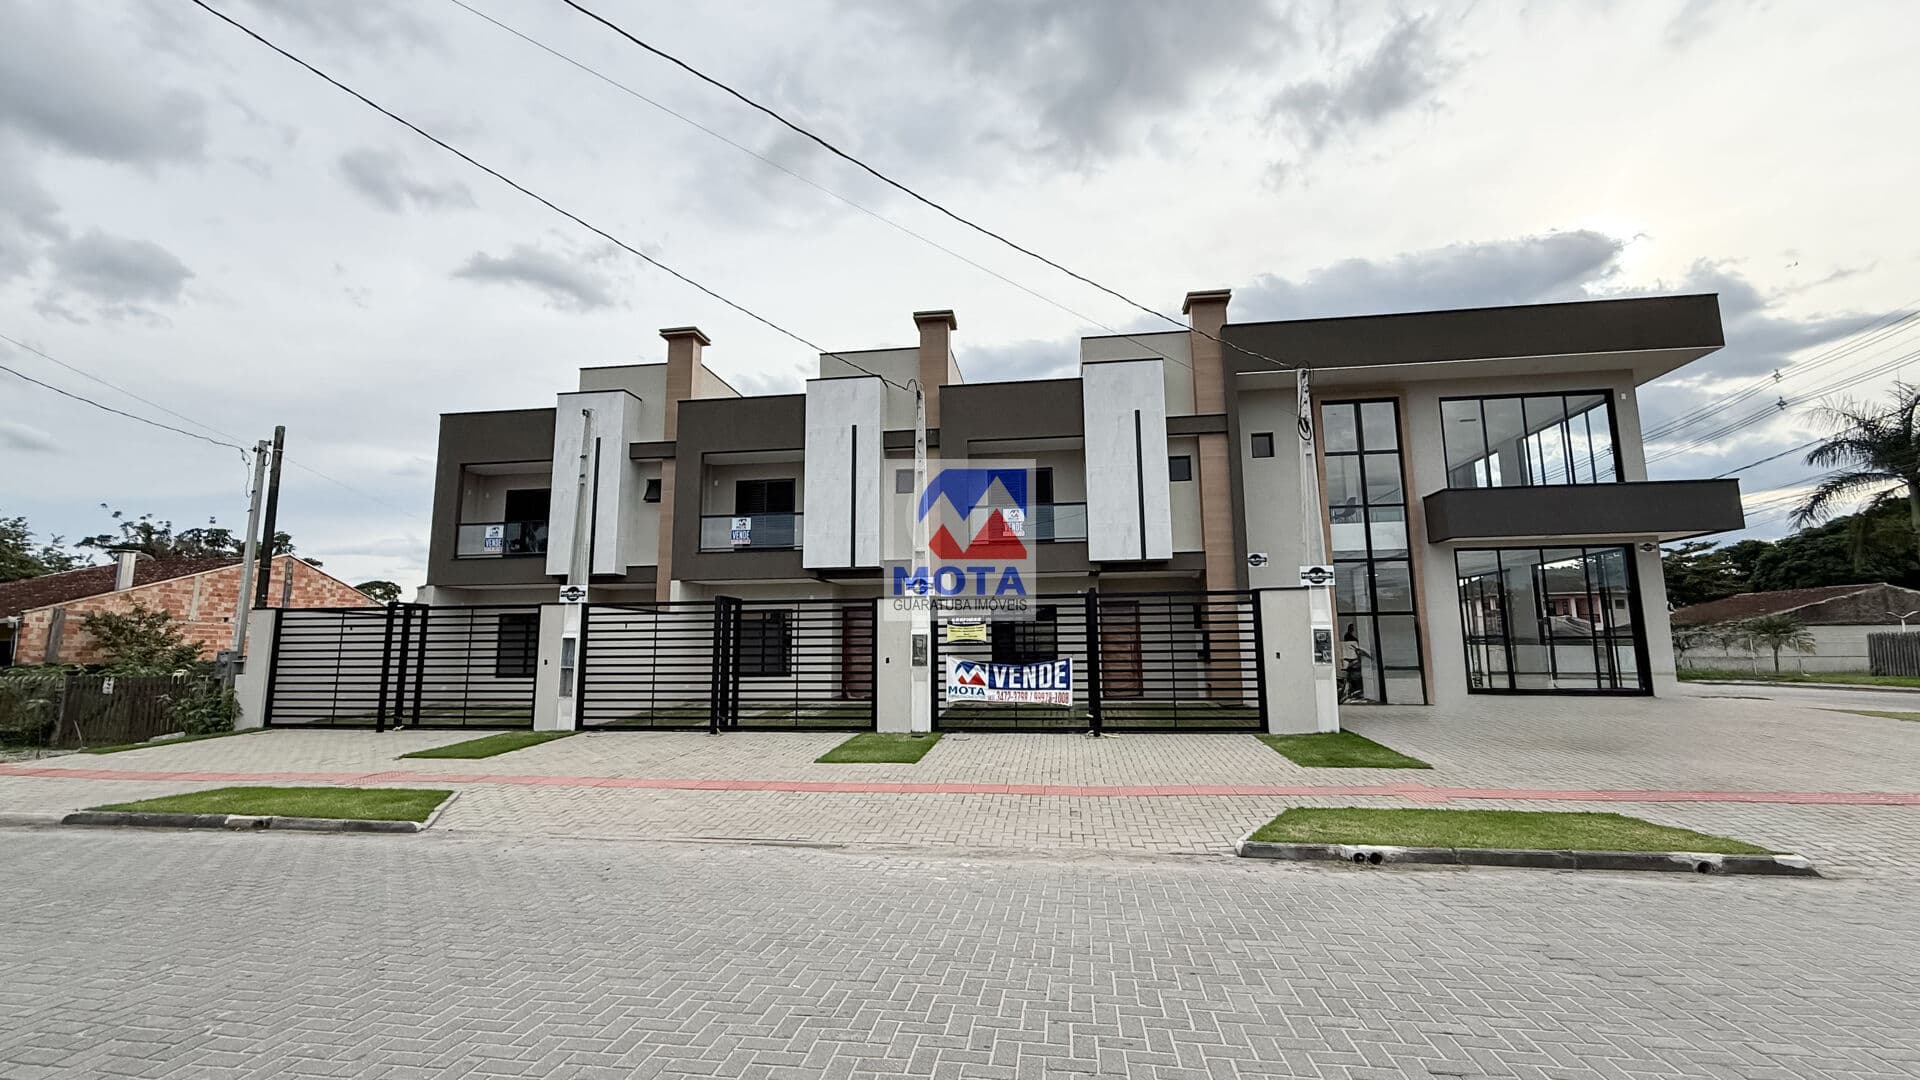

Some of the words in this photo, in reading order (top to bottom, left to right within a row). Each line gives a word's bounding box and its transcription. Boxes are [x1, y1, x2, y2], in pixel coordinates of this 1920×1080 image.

[732, 530, 750, 540] VENDE
[486, 539, 503, 547] VENDE
[993, 661, 1067, 688] VENDE
[948, 686, 985, 696] MOTA
